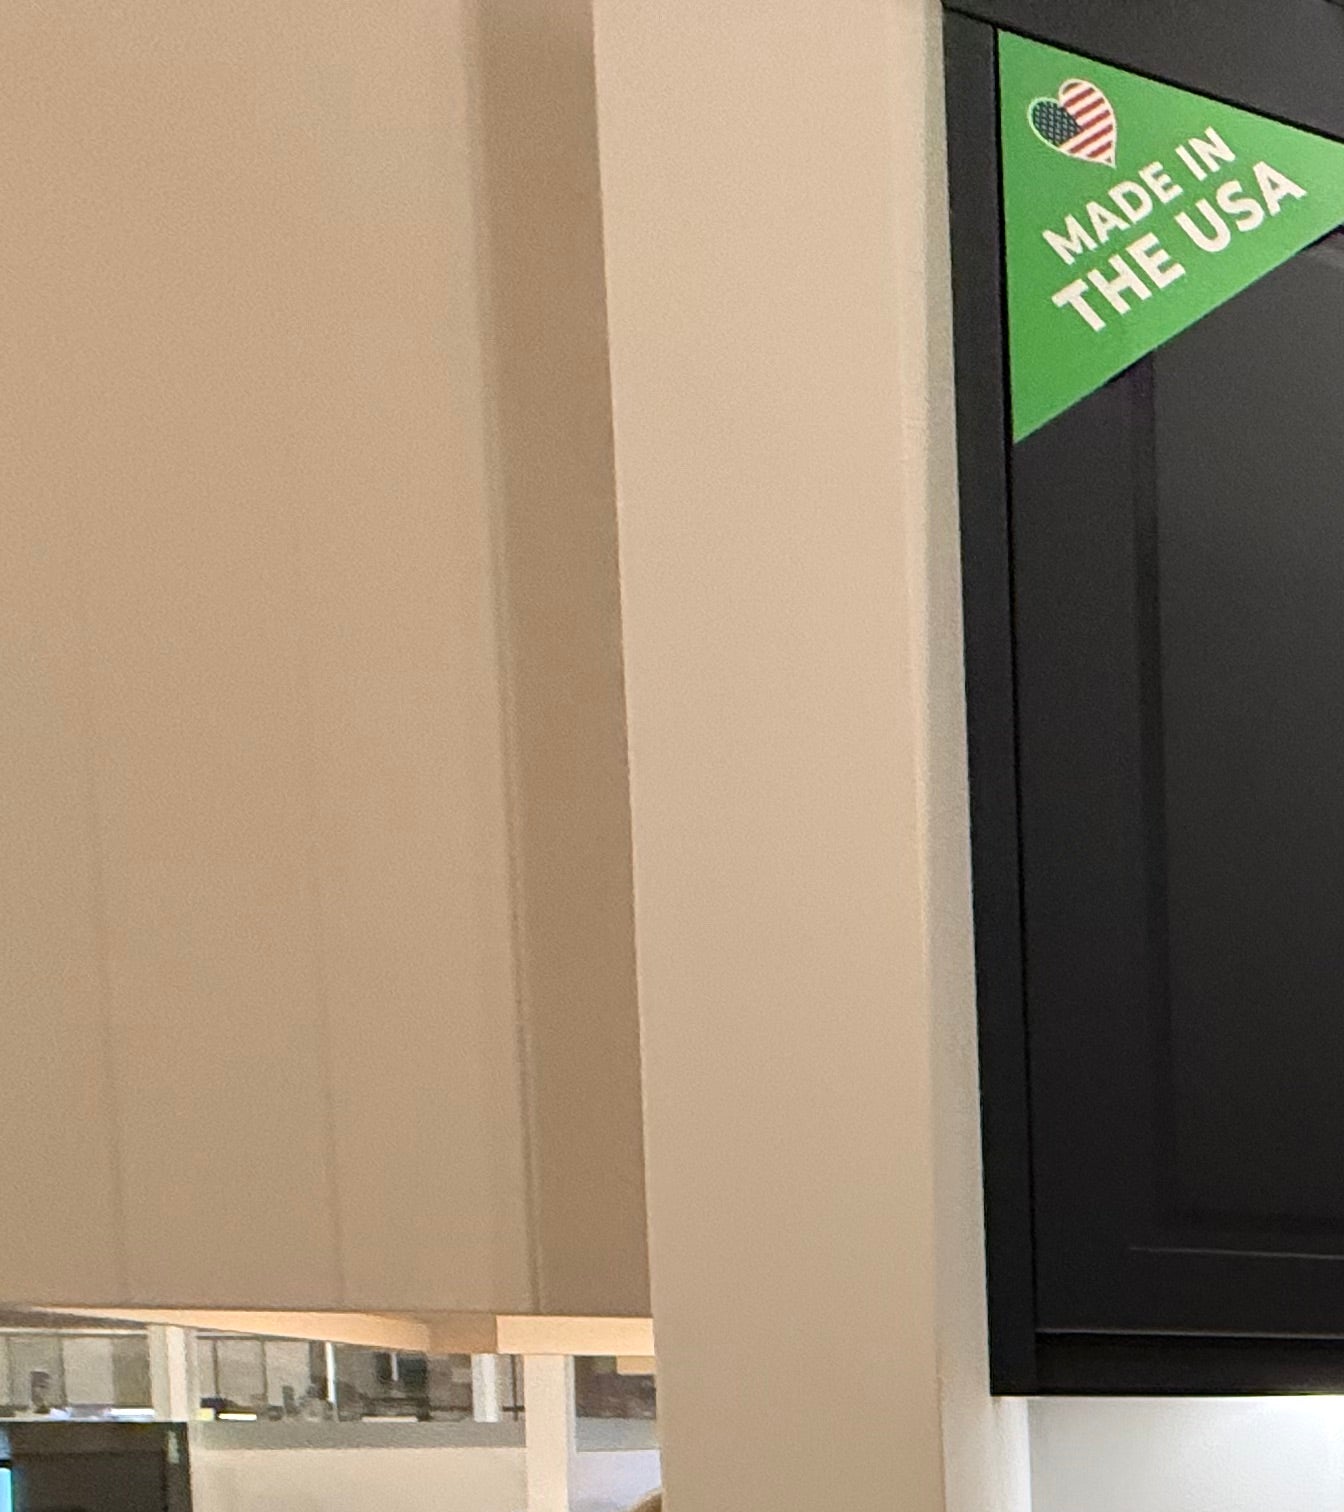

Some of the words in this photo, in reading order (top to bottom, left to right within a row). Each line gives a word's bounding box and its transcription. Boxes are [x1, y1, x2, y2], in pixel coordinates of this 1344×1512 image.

[1042, 162, 1183, 265] MADE
[1175, 127, 1236, 181] IN
[1051, 232, 1187, 332] THE
[1174, 161, 1308, 253] USA
